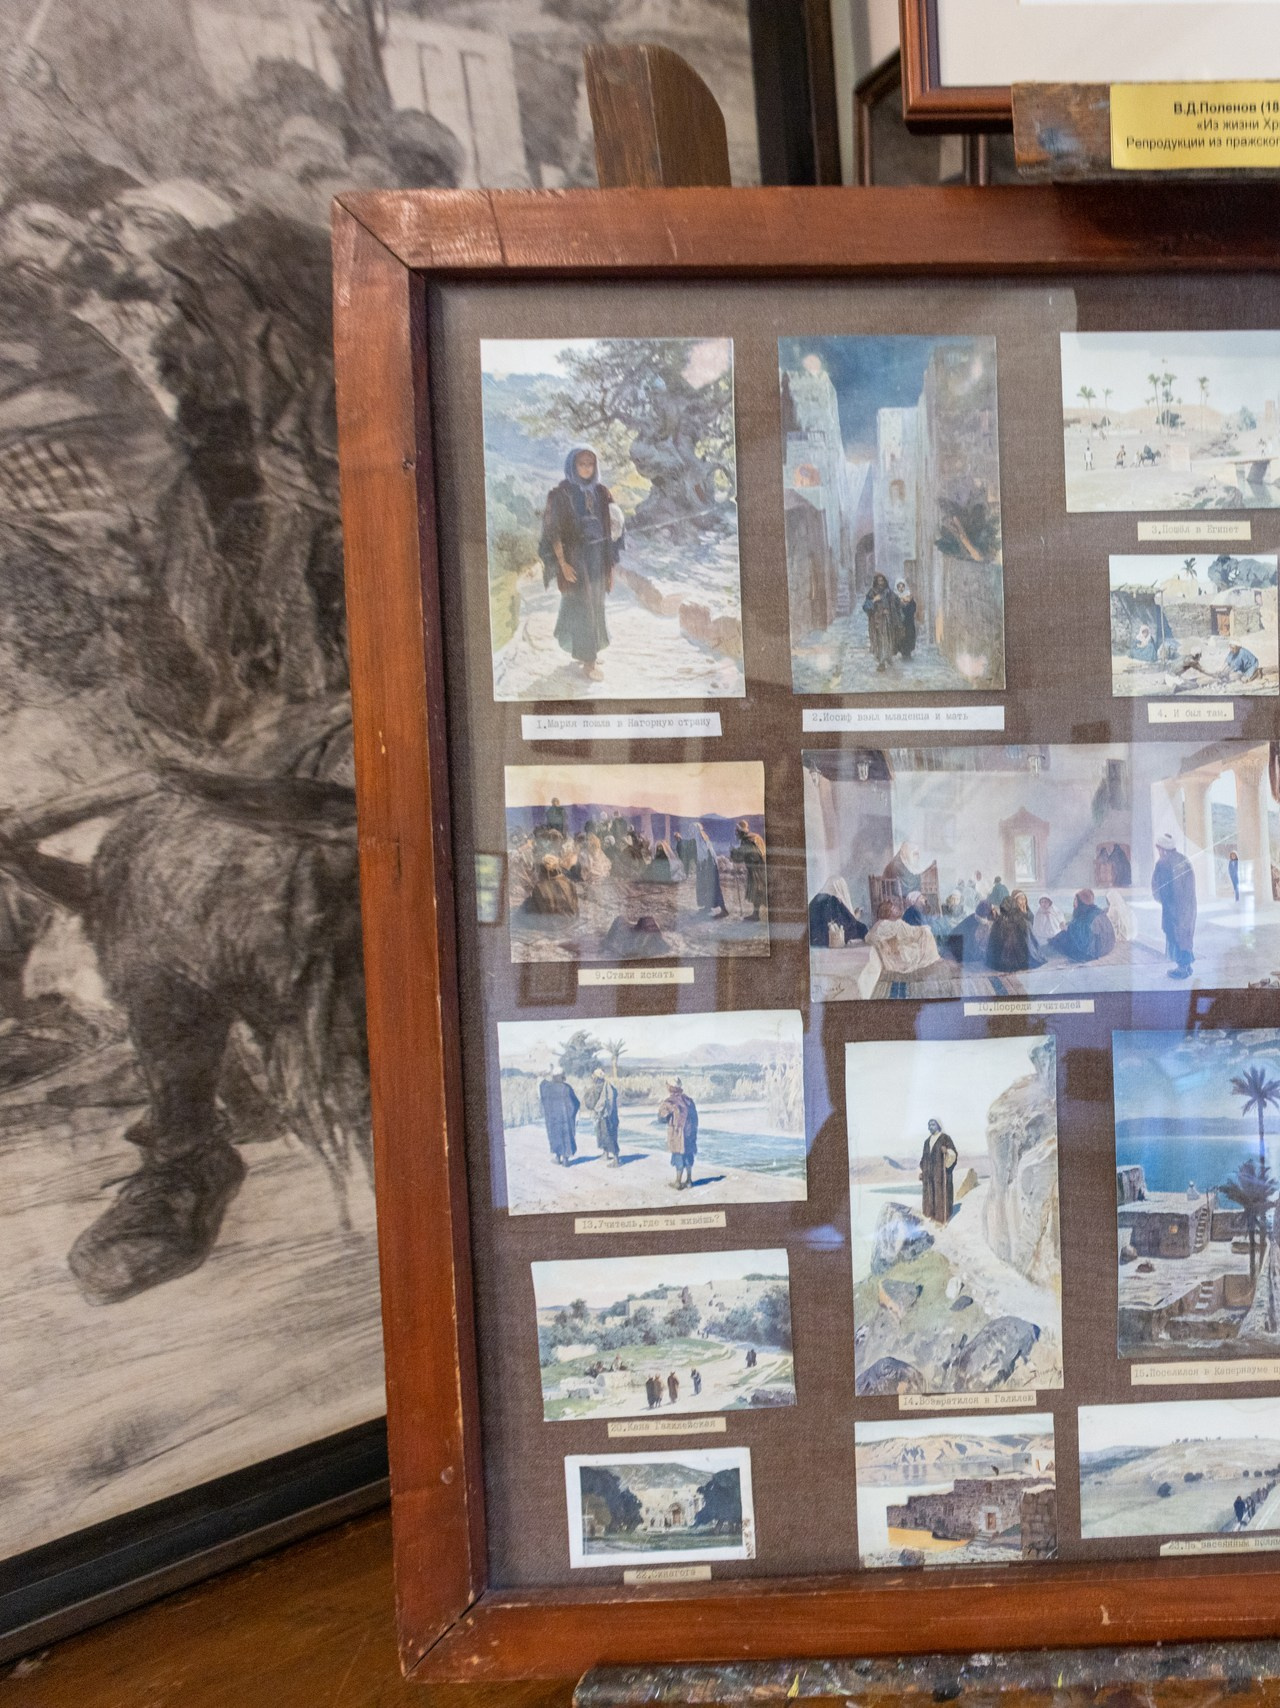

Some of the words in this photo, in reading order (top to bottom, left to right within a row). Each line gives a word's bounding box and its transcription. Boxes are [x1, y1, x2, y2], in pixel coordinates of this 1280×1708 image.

[1197, 120, 1219, 130] «Из
[1222, 120, 1259, 130] жизни
[1126, 136, 1205, 151] Репродукции
[1208, 138, 1222, 146] из
[1207, 524, 1239, 533] Египет
[812, 712, 853, 723] 2.Иосиф
[884, 713, 929, 722] младенца
[945, 712, 968, 720] мать
[1173, 709, 1179, 717] И
[1185, 709, 1201, 717] был
[1206, 710, 1227, 718] там.
[582, 719, 611, 728] пошла
[627, 718, 674, 729] Нагорную
[678, 718, 711, 729] страну
[595, 971, 635, 980] 9.Стали
[640, 970, 674, 979] искать
[1037, 1000, 1081, 1010] учителей
[1214, 1365, 1268, 1377] Капернауме
[994, 1393, 1034, 1404] Галилею
